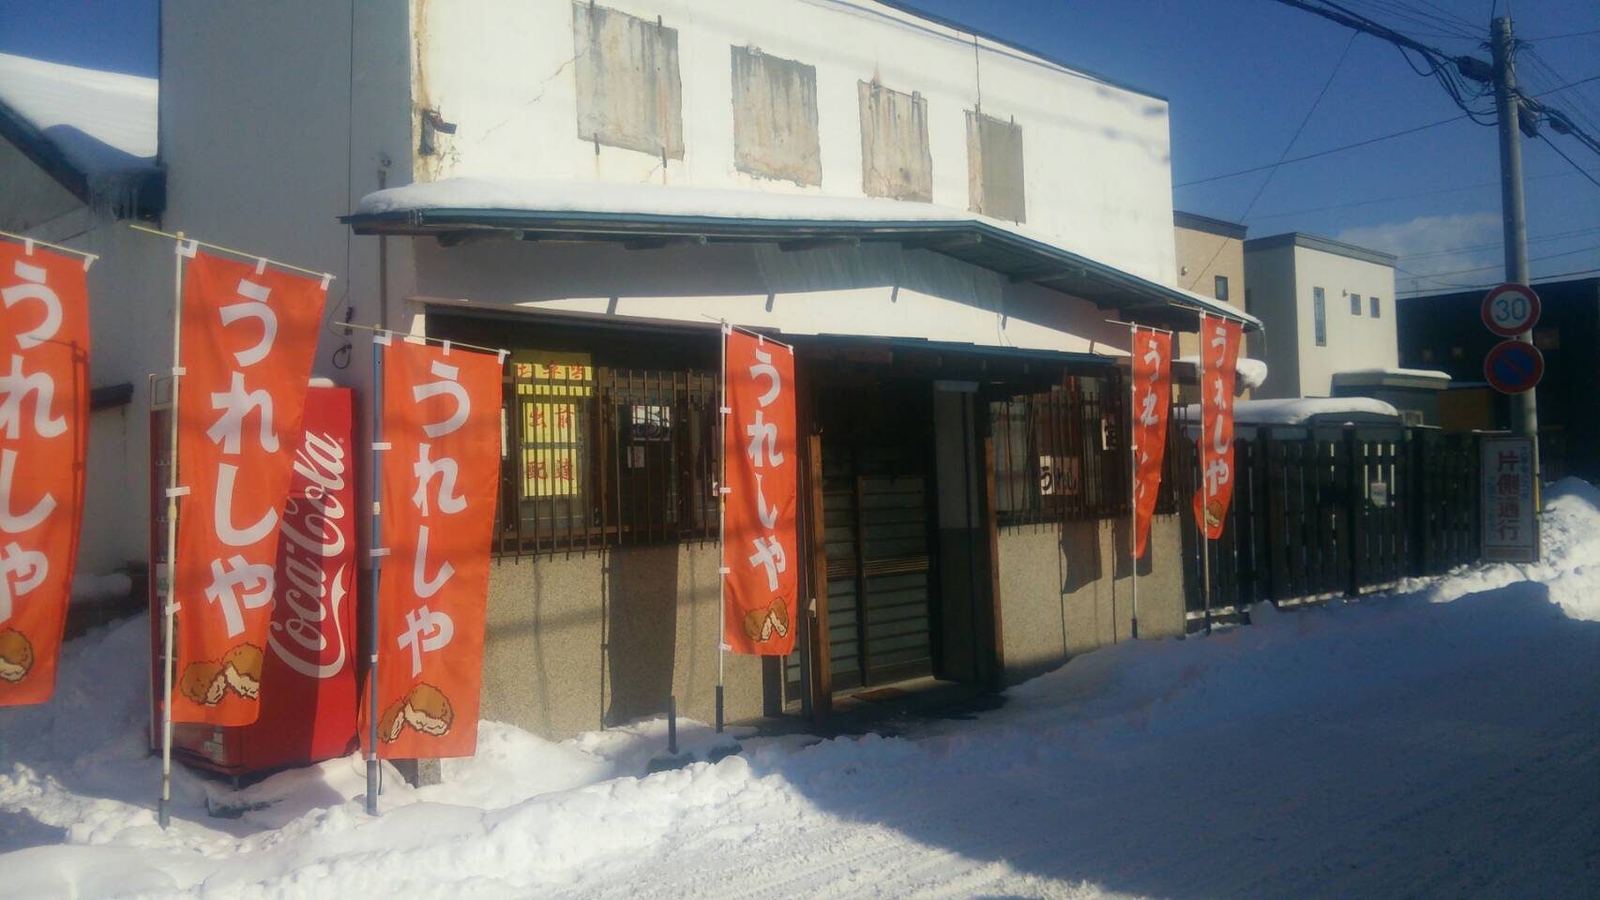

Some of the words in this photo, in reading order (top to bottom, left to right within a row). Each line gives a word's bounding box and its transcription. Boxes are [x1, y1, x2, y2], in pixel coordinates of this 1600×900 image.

[1495, 299, 1527, 322] 30
[206, 277, 280, 639] うれしや
[268, 430, 345, 678] Coca-Cola
[398, 360, 471, 679] うれしや
[747, 348, 786, 593] うれしや
